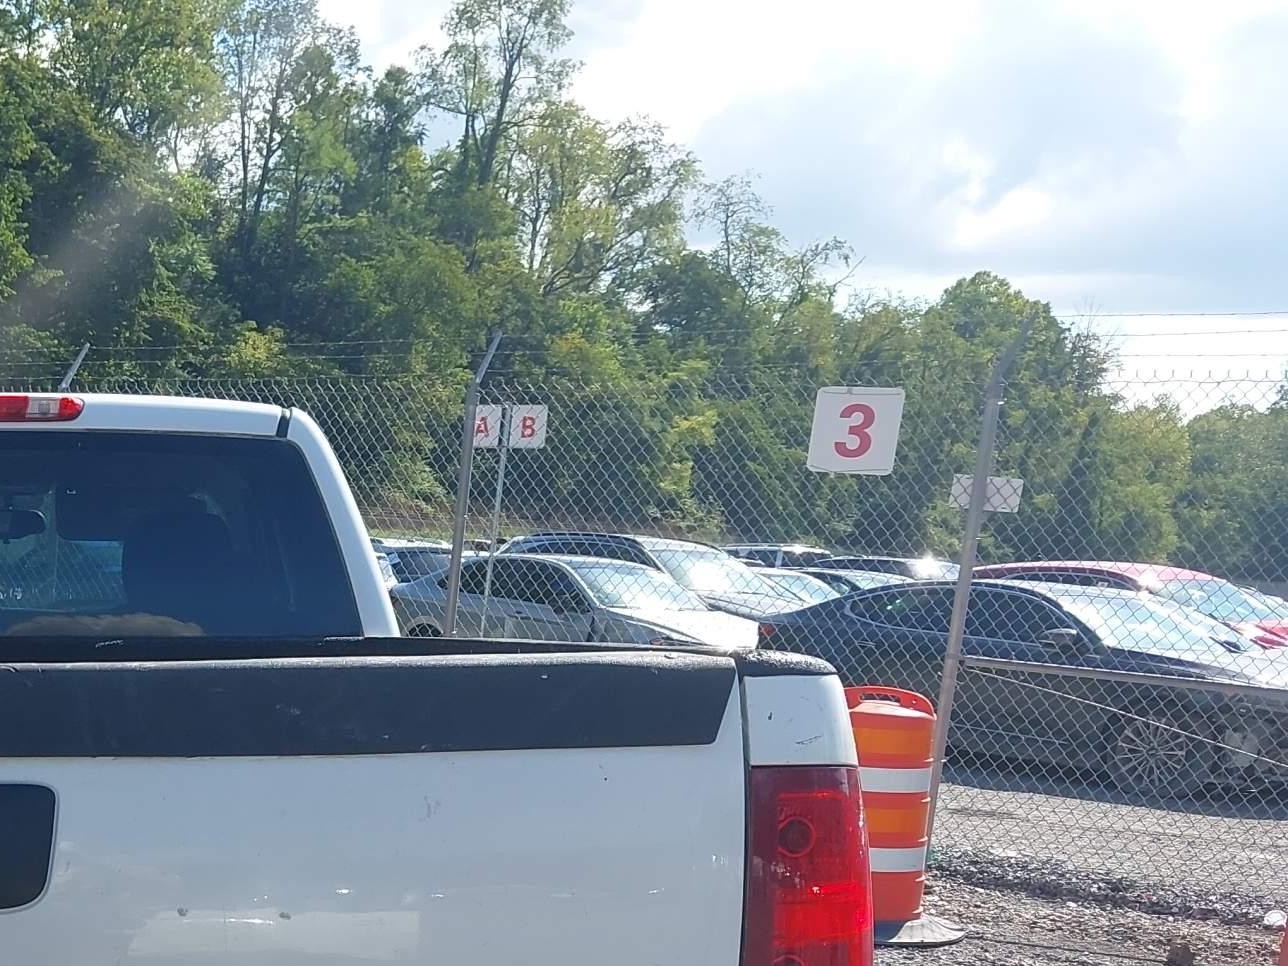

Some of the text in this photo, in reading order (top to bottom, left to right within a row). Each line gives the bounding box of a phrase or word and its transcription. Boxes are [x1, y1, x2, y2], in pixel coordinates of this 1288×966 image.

[475, 416, 489, 438] A
[520, 416, 536, 438] B
[834, 403, 876, 458] 3
